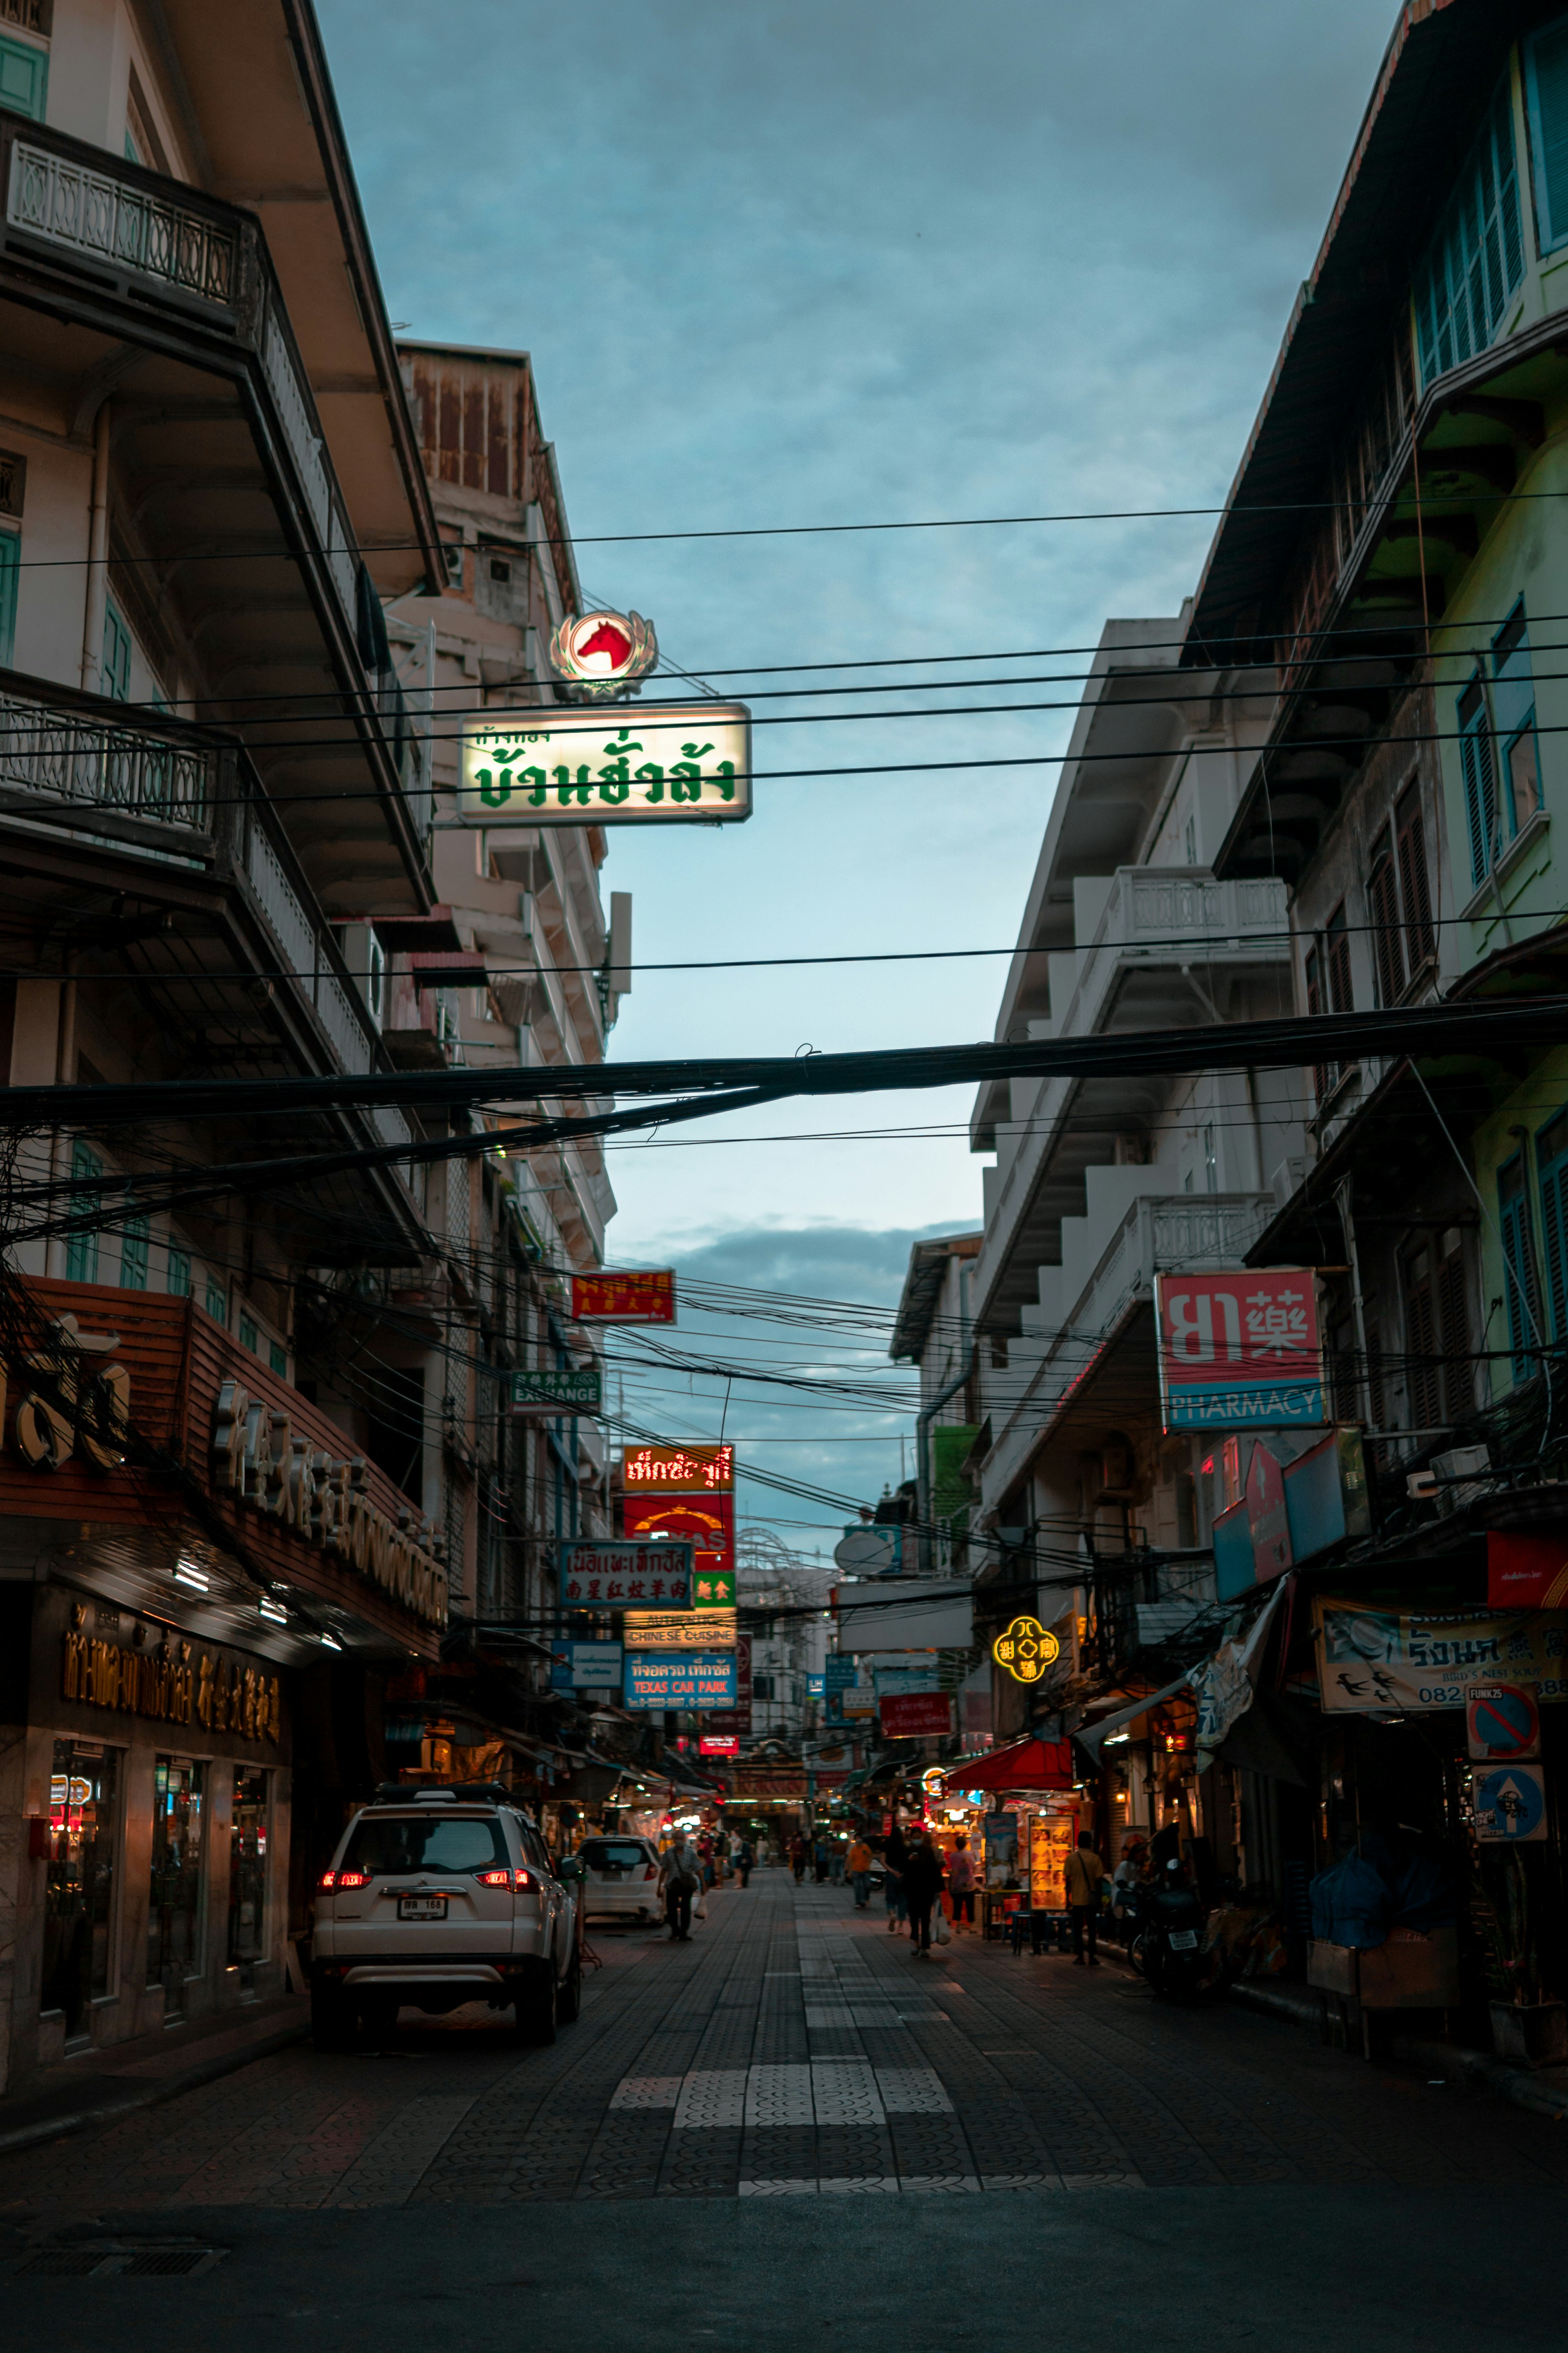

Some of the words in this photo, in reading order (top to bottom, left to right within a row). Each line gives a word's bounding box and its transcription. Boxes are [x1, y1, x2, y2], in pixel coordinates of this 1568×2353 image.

[1245, 1289, 1308, 1358] 藥
[1171, 1388, 1317, 1420] PHARMACY
[630, 1631, 682, 1641] CHINESE
[685, 1630, 733, 1641] CUISINE
[1018, 1622, 1034, 1637] 八
[1409, 1628, 1503, 1667] รังนก
[631, 1656, 686, 1677] ที่จอดรถ
[688, 1657, 731, 1676] เท็กซัส
[1443, 1670, 1478, 1682] BIRD'S
[1482, 1669, 1511, 1679] NEST
[1512, 1666, 1543, 1677] SOUP
[634, 1681, 668, 1694] TEXAS
[671, 1681, 695, 1693] CAR
[698, 1680, 728, 1693] PARK
[1470, 1688, 1502, 1699] FUNK25
[426, 1900, 441, 1909] 168
